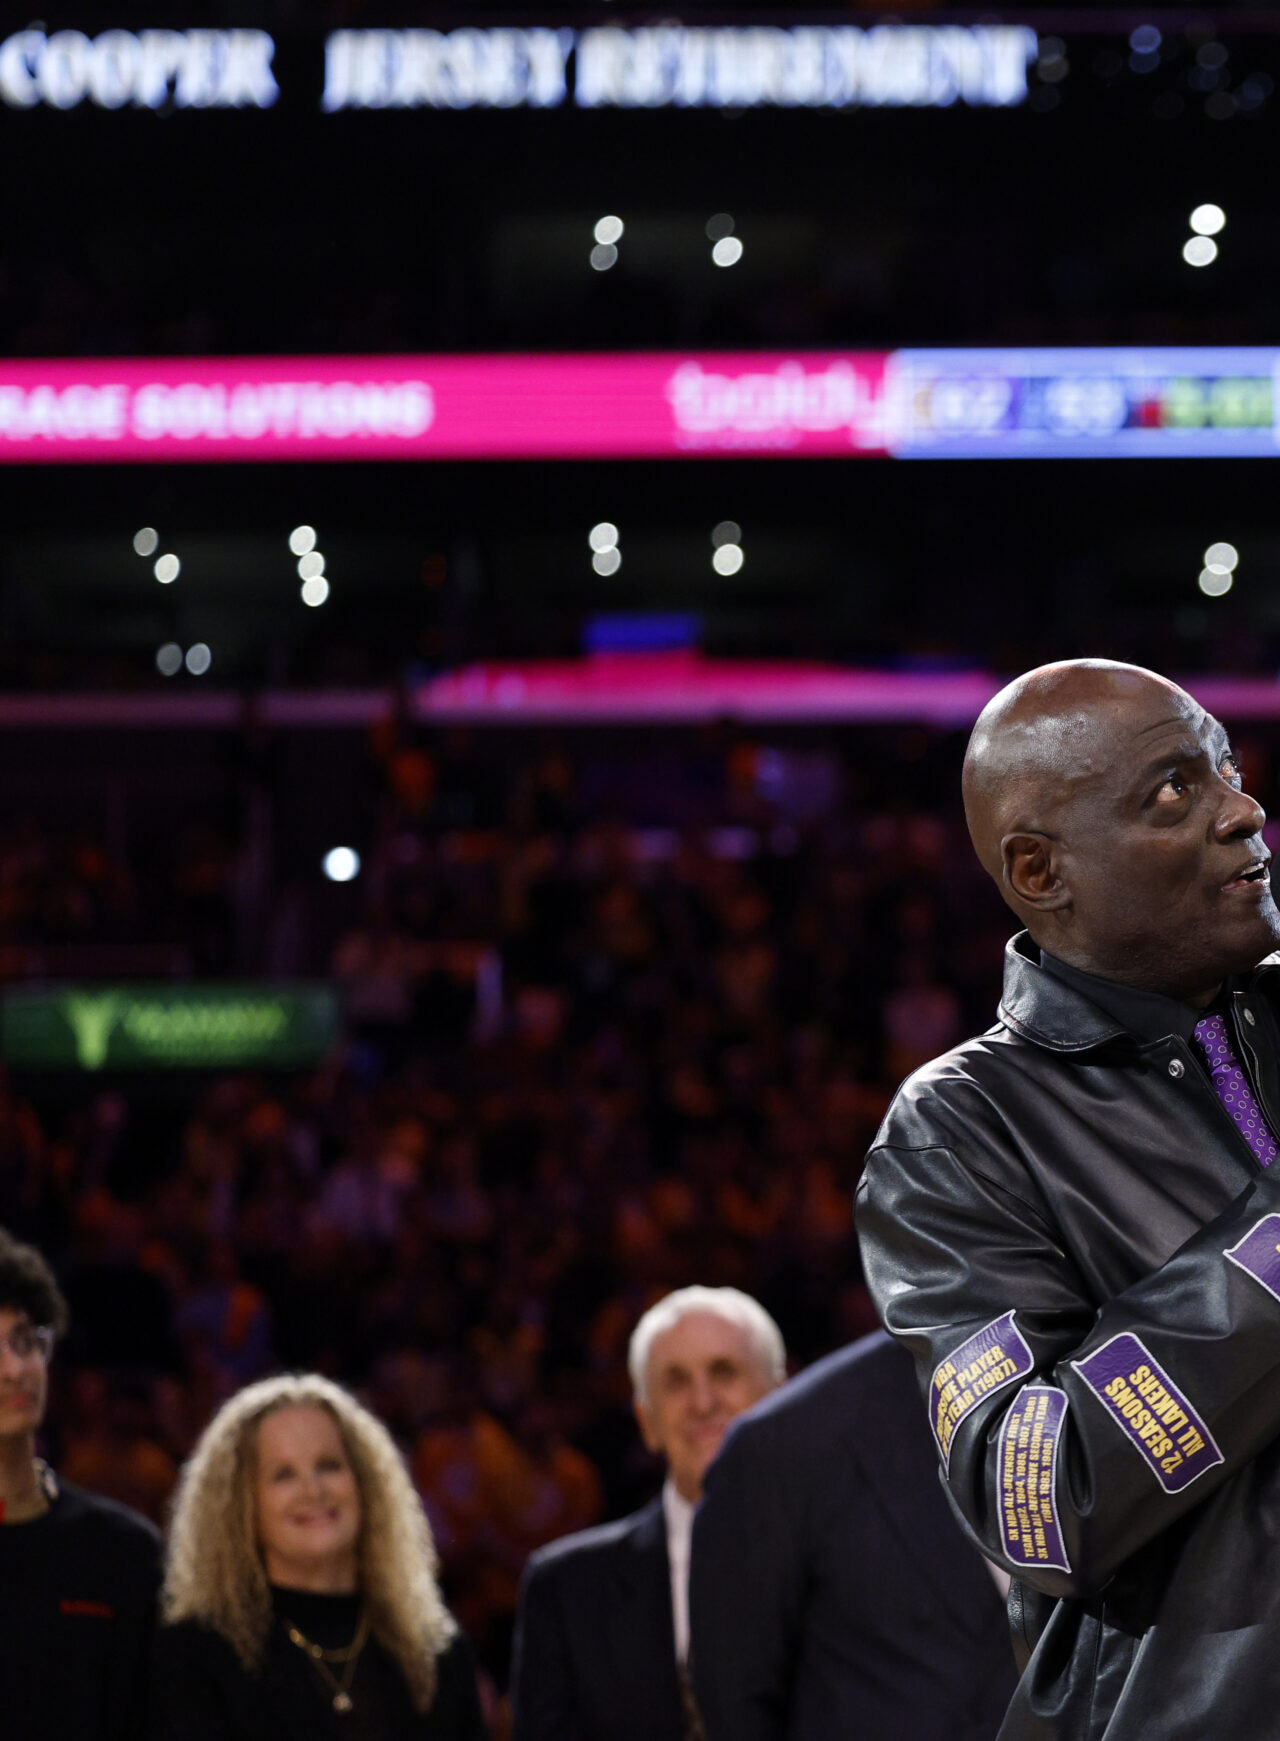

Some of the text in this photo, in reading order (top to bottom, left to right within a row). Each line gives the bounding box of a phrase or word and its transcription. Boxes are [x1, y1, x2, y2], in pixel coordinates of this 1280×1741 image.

[0, 28, 279, 109] COOPER
[322, 25, 1037, 112] JERSEY RETIREMENT
[134, 380, 434, 440] SOLUTIONS
[934, 1361, 957, 1392] NBA
[948, 1389, 975, 1423] YEAR
[972, 1358, 1018, 1396] (1987)
[956, 1345, 1006, 1389] PLAYER
[1035, 1395, 1049, 1420] TEAM
[1104, 1376, 1184, 1474] 12 SEASONS
[1129, 1364, 1206, 1458] ALL LAKERS
[1028, 1423, 1043, 1461] SECOND
[1003, 1413, 1021, 1541] 5X NBA ALL-DEFENSIVE FIRST
[1027, 1462, 1043, 1527] ALL-DEFENSIVE
[1022, 1534, 1035, 1557] TEAM
[1034, 1528, 1046, 1546] NBA
